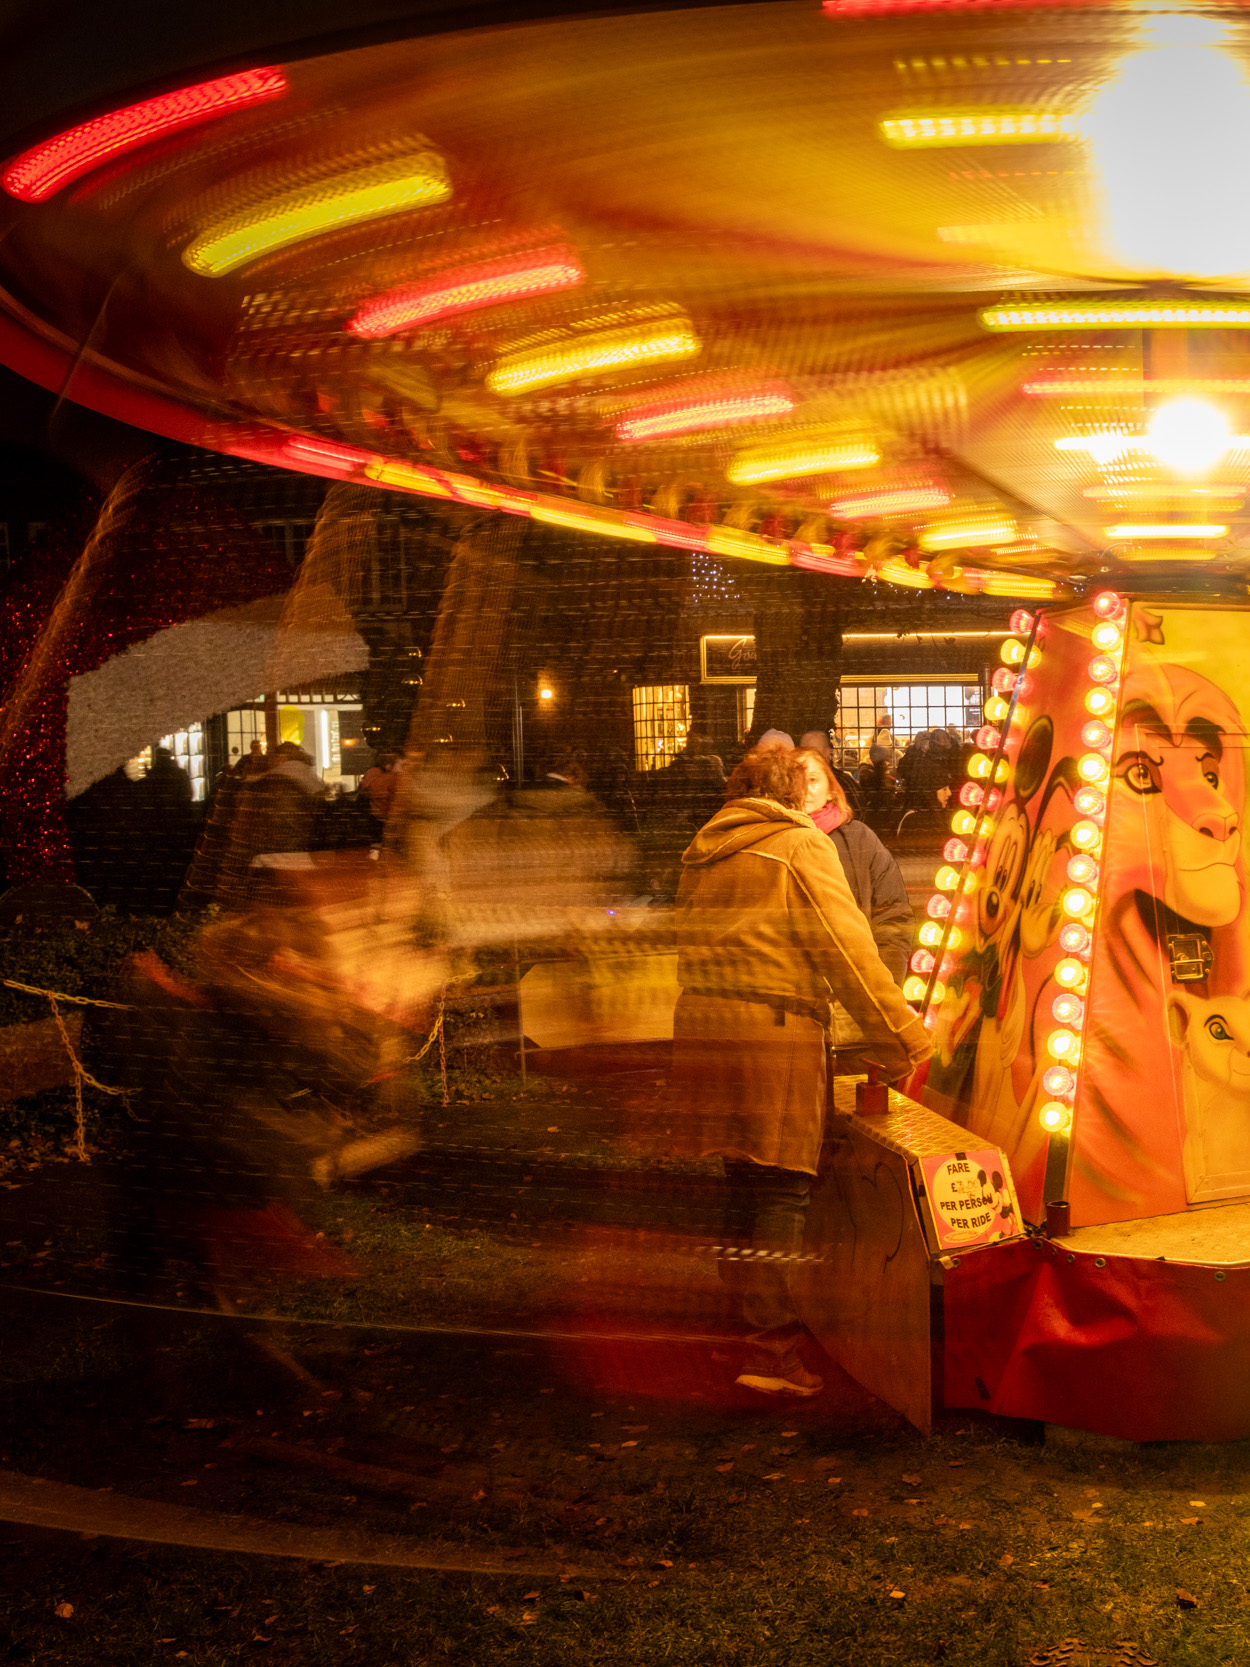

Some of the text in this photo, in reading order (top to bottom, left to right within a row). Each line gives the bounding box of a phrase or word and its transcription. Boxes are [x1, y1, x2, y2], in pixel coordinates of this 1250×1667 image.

[947, 1162, 970, 1175] FARE
[940, 1193, 993, 1211] PER PERSON
[950, 1212, 992, 1229] PER RIDE
